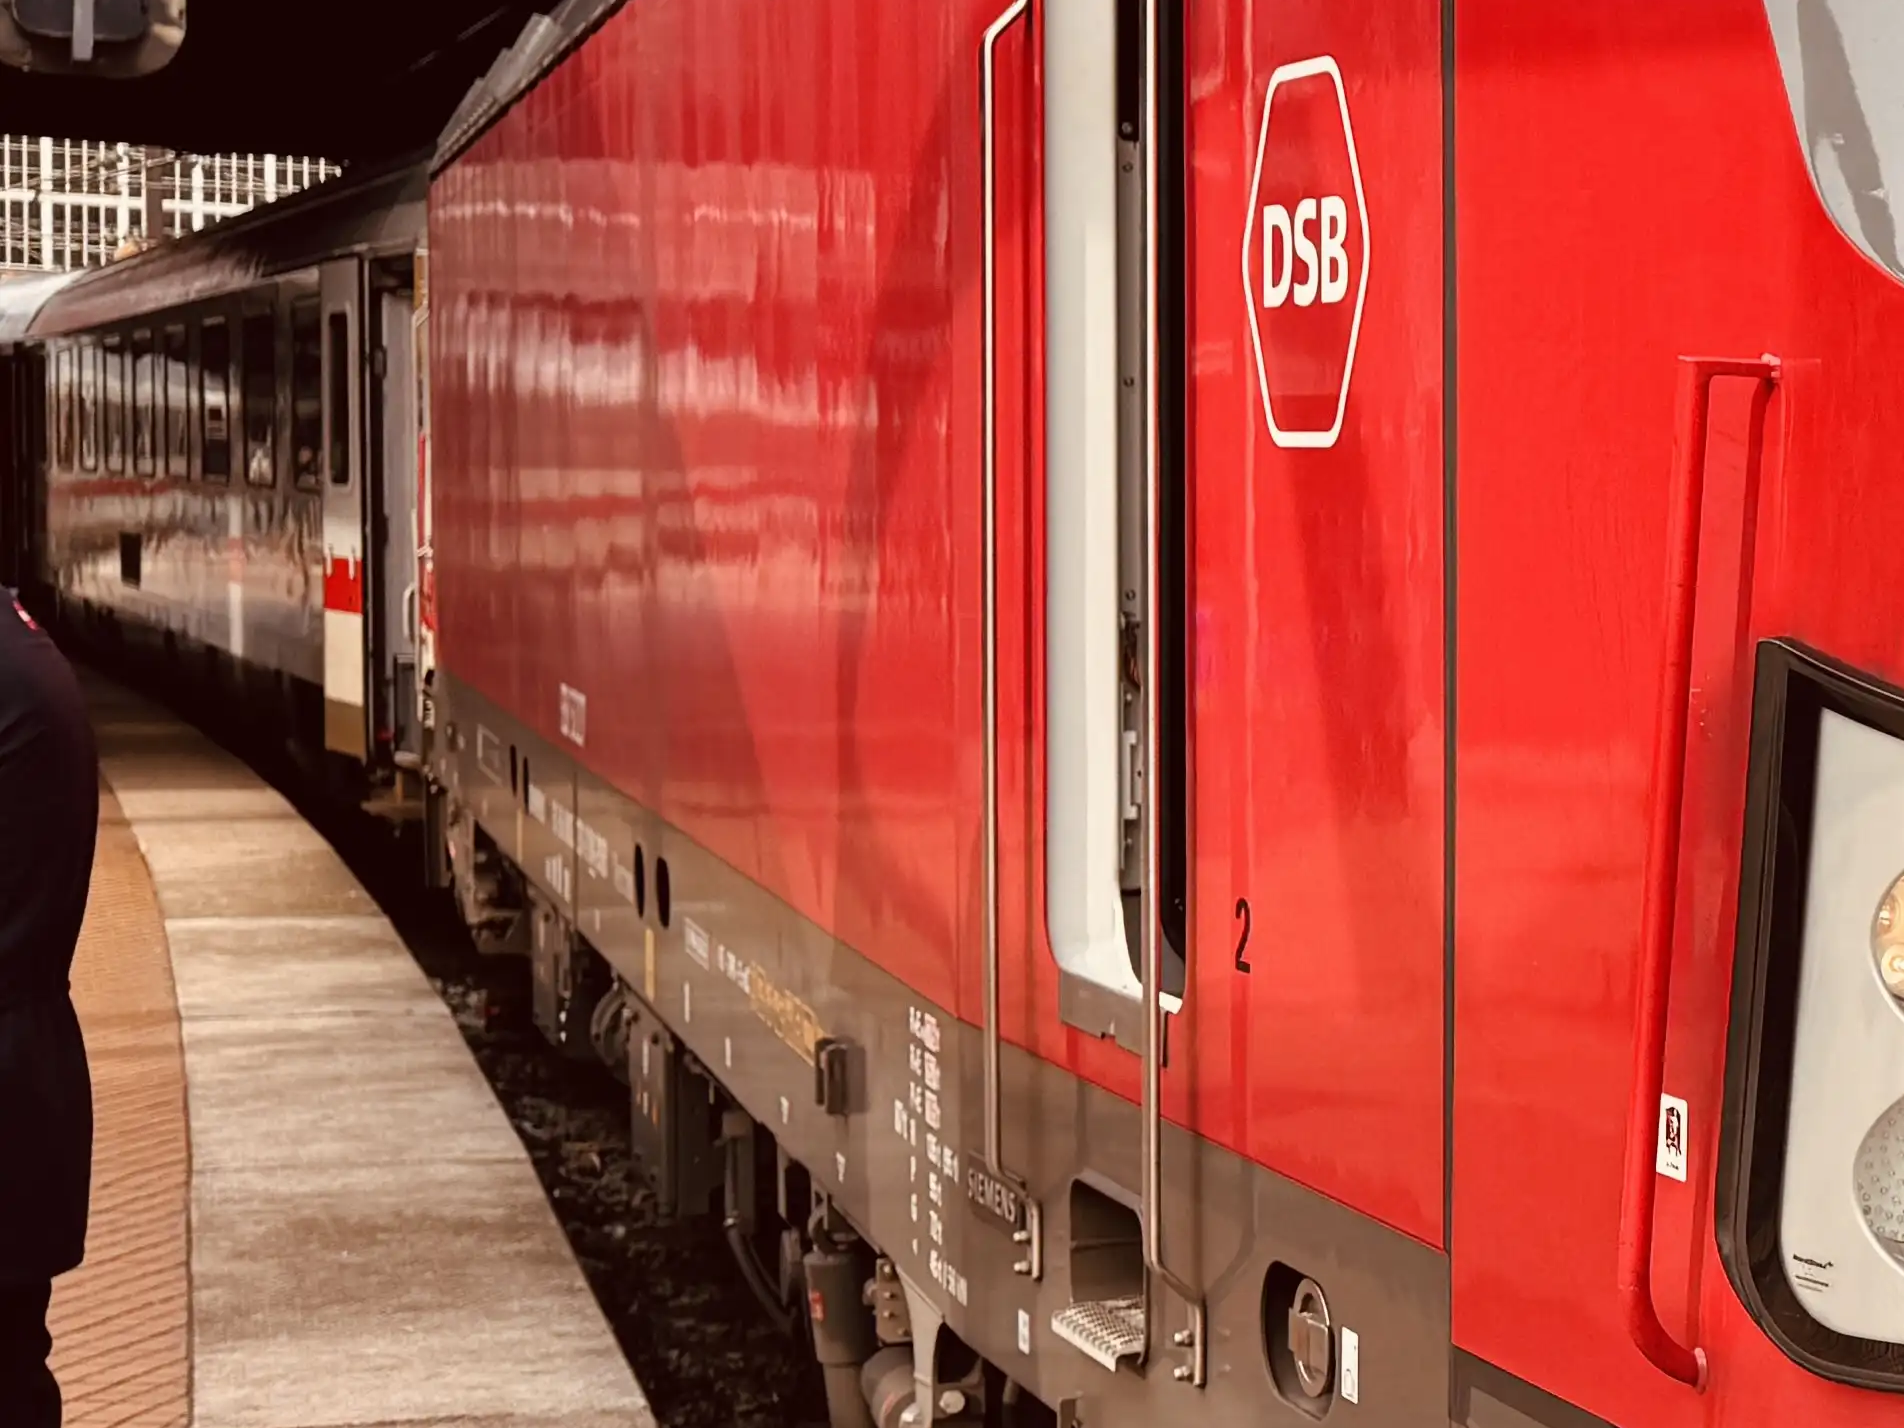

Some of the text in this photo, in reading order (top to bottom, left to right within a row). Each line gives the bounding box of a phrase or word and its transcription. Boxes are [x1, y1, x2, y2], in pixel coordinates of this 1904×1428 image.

[1263, 195, 1349, 308] DSB
[1235, 897, 1251, 974] 2
[967, 1167, 1016, 1224] SIEMENS
